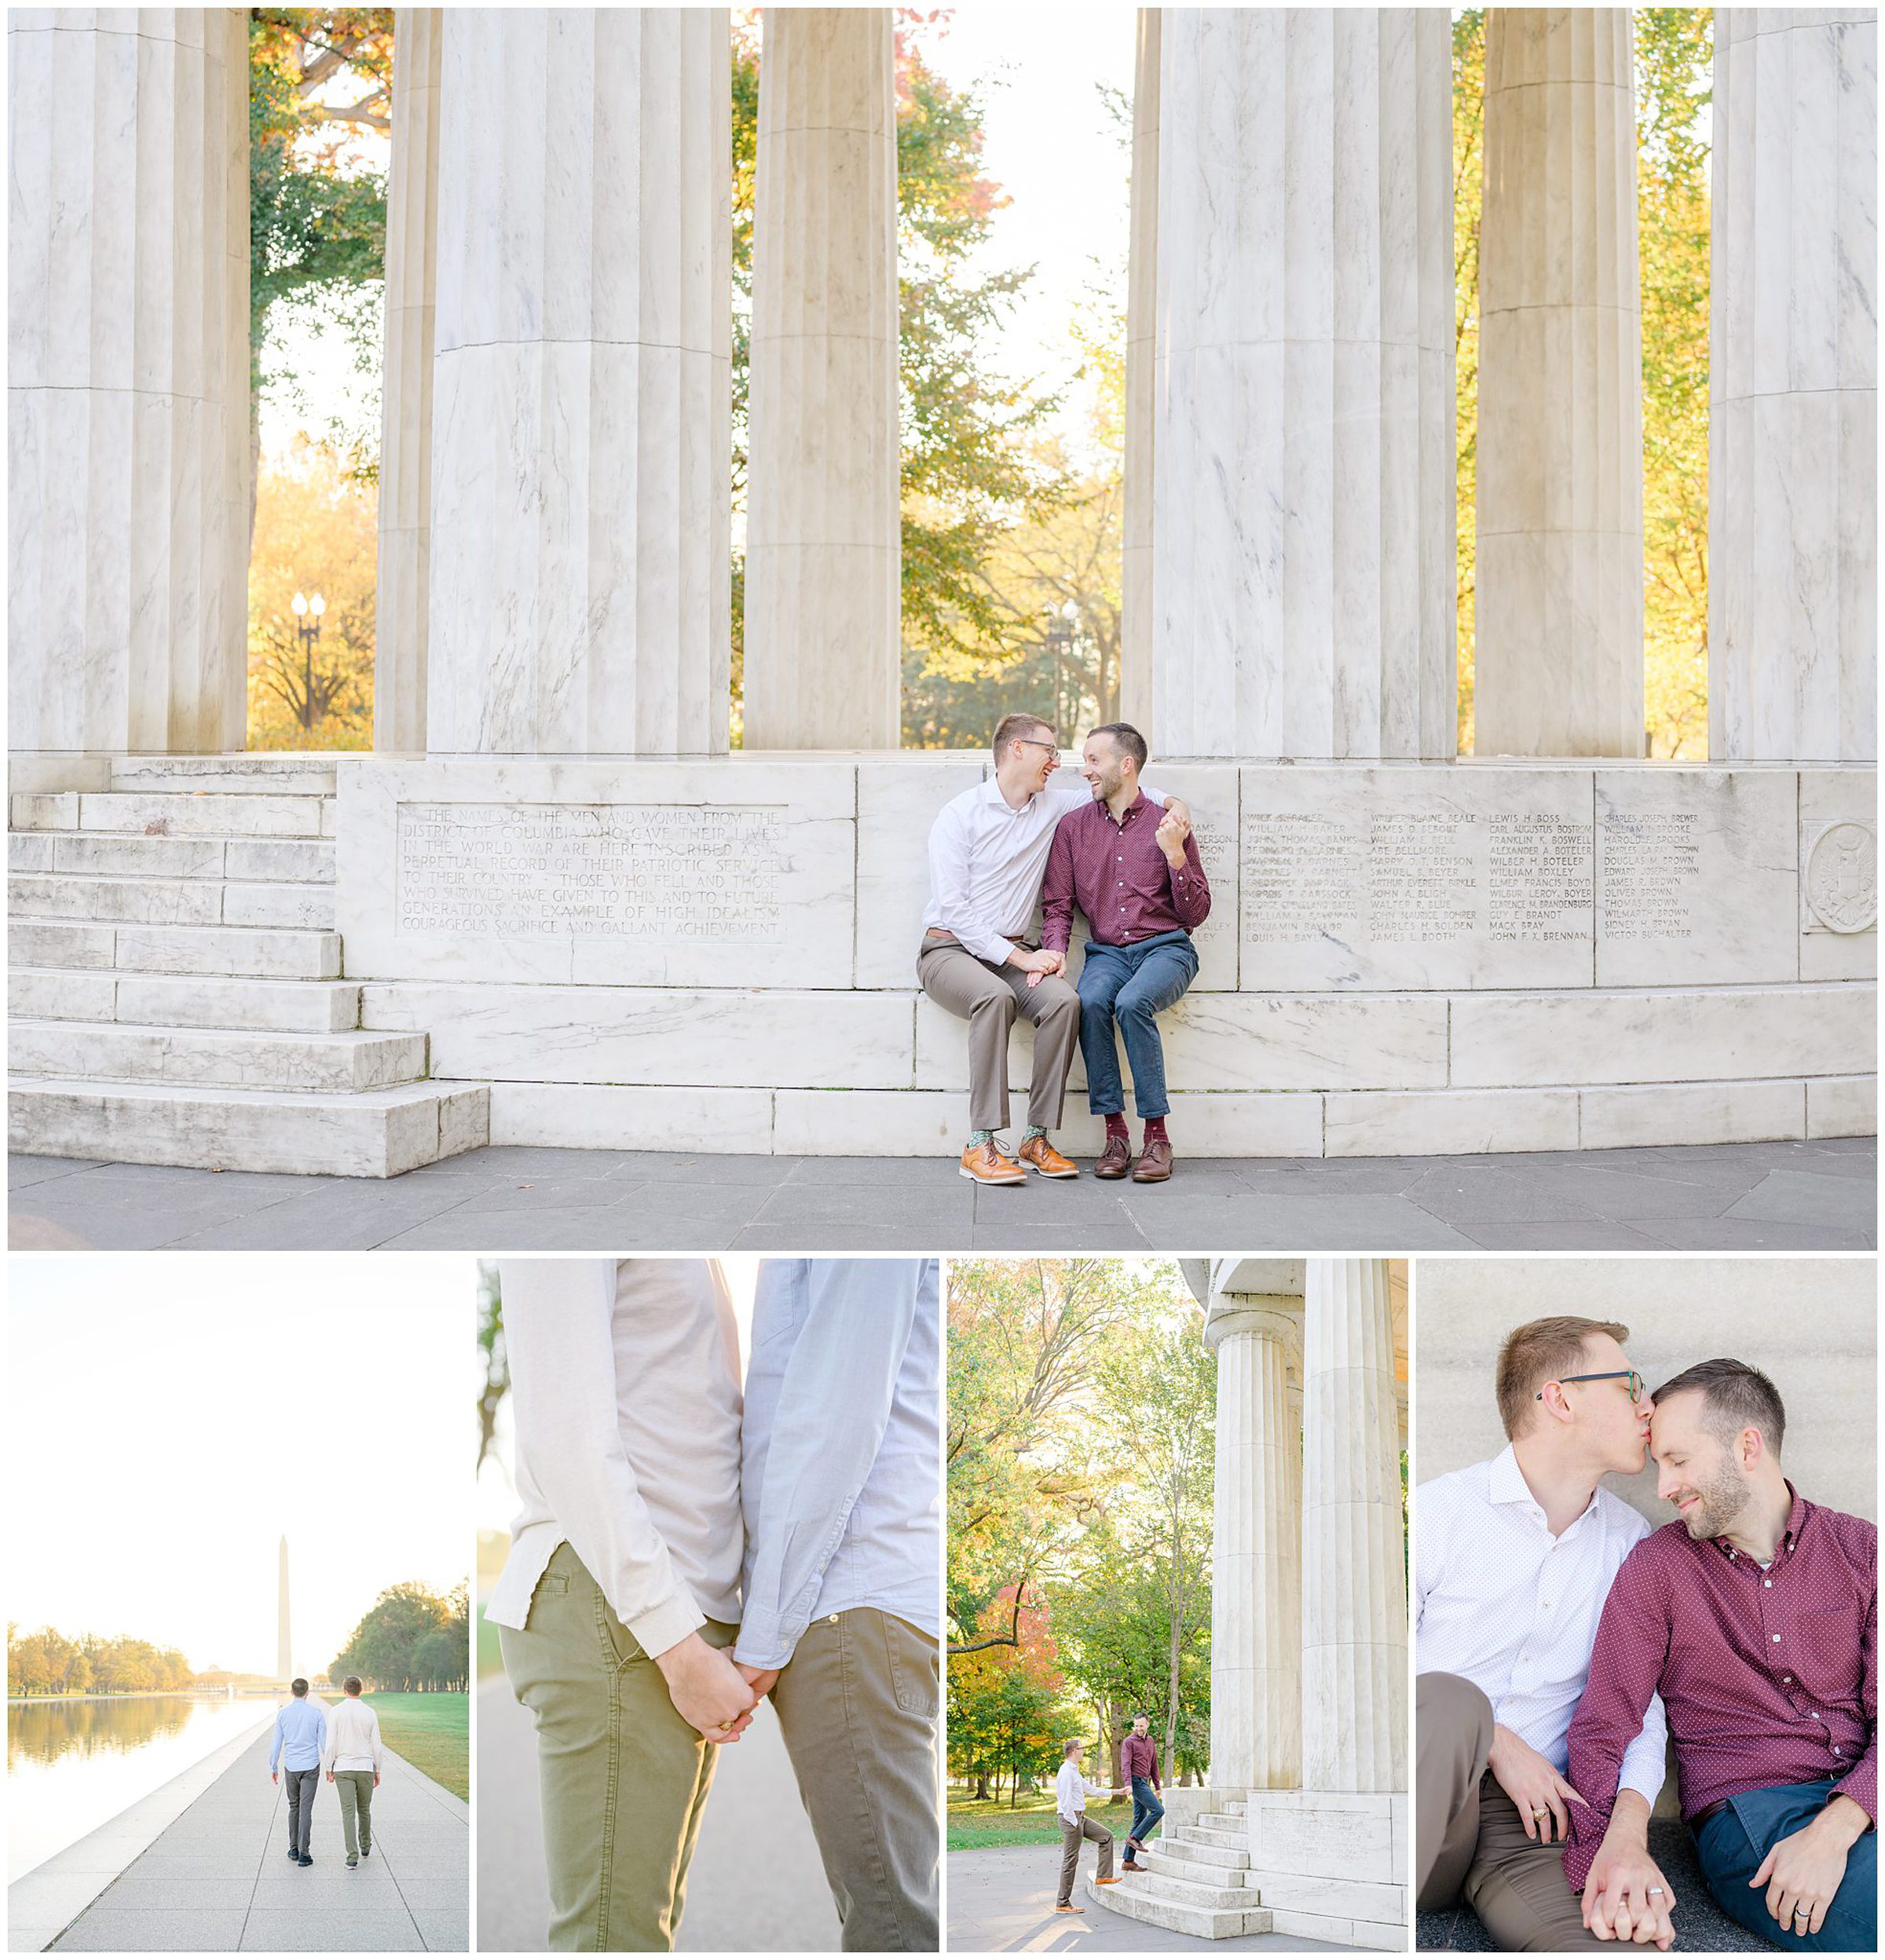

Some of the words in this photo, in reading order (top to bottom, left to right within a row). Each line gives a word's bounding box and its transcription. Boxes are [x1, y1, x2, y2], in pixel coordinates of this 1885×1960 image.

[426, 809, 452, 822] THE
[459, 810, 503, 823] NAMES
[511, 810, 529, 823] OF
[537, 810, 562, 823] THE
[570, 810, 599, 824] MEN
[607, 811, 635, 825] AND
[642, 812, 696, 825] WOMEN
[704, 812, 741, 825] FROM
[752, 812, 780, 825] THE
[1411, 814, 1442, 823] BLAINE
[1448, 814, 1477, 823] BEALE
[1489, 814, 1519, 824] LEWIS
[1536, 814, 1561, 823] BOSS
[1604, 814, 1637, 824] CHARLES
[1639, 814, 1667, 823] JOSEPH
[1671, 814, 1700, 823] BREWER
[404, 825, 463, 838] DISTRICT
[474, 826, 491, 839] OF
[501, 826, 577, 839] COLUMBIA
[585, 827, 622, 839] WHO
[631, 828, 669, 840] GAVE
[680, 828, 725, 840] THEIR
[735, 828, 779, 841] LIVES
[1371, 825, 1404, 834] JAMES
[1489, 825, 1509, 834] CARL
[1513, 825, 1553, 834] AUGUSTUS
[1371, 836, 1415, 845] WILLIAM
[1489, 836, 1533, 845] FRANKLIN
[1552, 836, 1592, 845] BOSWELL
[1604, 836, 1641, 845] HAROLD
[404, 840, 416, 853] IN
[425, 840, 452, 854] THE
[461, 841, 513, 854] WORLD
[522, 842, 553, 854] WAR
[562, 842, 590, 855] ARE
[600, 843, 639, 856] HERE
[741, 844, 760, 857] AS
[1371, 847, 1390, 855] ABE
[1395, 847, 1447, 855] BELLMORE
[1490, 847, 1539, 855] ALEXANDER
[490, 857, 547, 870] RECORD
[555, 858, 573, 871] OF
[582, 858, 623, 872] THEIR
[633, 858, 706, 872] PATRIOTIC
[716, 859, 779, 872] SERVICE
[1433, 857, 1473, 866] BENSON
[1543, 857, 1584, 866] BOTELER
[1604, 857, 1645, 866] DOUGLAS
[1663, 856, 1695, 865] BROWN
[1371, 868, 1412, 877] SAMUEL
[1429, 868, 1459, 877] BEYER
[1490, 868, 1533, 877] WILLIAM
[1538, 868, 1574, 877] BOXLEY
[1604, 867, 1636, 876] EDWARD
[1673, 866, 1700, 876] BROWN
[404, 871, 421, 883] TO
[429, 872, 465, 884] THEIR
[473, 872, 532, 885] COUNTRY
[559, 873, 604, 887] THOSE
[611, 874, 646, 887] WHO
[654, 874, 686, 888] FELL
[697, 875, 725, 888] AND
[733, 875, 780, 889] THOSE
[1371, 879, 1404, 888] ARTHUR
[1490, 879, 1518, 887] ELMER
[1524, 879, 1562, 887] FRANCIS
[1568, 879, 1591, 887] BOYD
[1605, 878, 1634, 887] JAMES
[1650, 877, 1682, 887] BROWN
[404, 887, 437, 900] WHO
[443, 887, 503, 901] SURVIVED
[511, 888, 545, 902] HAVE
[552, 889, 594, 903] GIVEN
[600, 890, 619, 903] TO
[625, 890, 657, 904] THIS
[663, 890, 692, 904] AND
[697, 890, 718, 905] TO
[724, 891, 780, 905] FUTURE
[1371, 890, 1399, 898] JOHN
[1565, 889, 1592, 898] BOYER
[1604, 888, 1637, 898] OLIVER
[1642, 887, 1672, 897] BROWN
[1371, 900, 1411, 909] WALTER
[1428, 900, 1451, 909] BLUE
[1539, 900, 1593, 909] BRANDENBURG
[1647, 898, 1678, 908] BROWN
[402, 901, 503, 916] GENERATIONS
[541, 905, 615, 918] EXAMPLE
[624, 905, 646, 919] OF
[657, 905, 697, 920] HIGH
[1490, 911, 1509, 920] GUY
[1526, 910, 1563, 920] BRANDT
[1658, 908, 1689, 917] BROWN
[1371, 911, 1395, 920] JOHN
[402, 916, 488, 932] COURAGEOUS
[495, 918, 558, 934] SACRIFICE
[566, 920, 595, 934] AND
[601, 920, 667, 935] GALLANT
[675, 921, 780, 937] ACHIEVEMENT
[1371, 922, 1415, 931] CHARLES
[1435, 922, 1473, 931] BOLDEN
[1489, 922, 1516, 931] MACK
[1605, 920, 1636, 929] SIDNEY
[1246, 934, 1276, 943] LOUIS
[1371, 933, 1404, 942] JAMES
[1422, 932, 1456, 942] BOOTH
[1489, 932, 1517, 942] JOHN
[1543, 932, 1587, 941] BRENNAN
